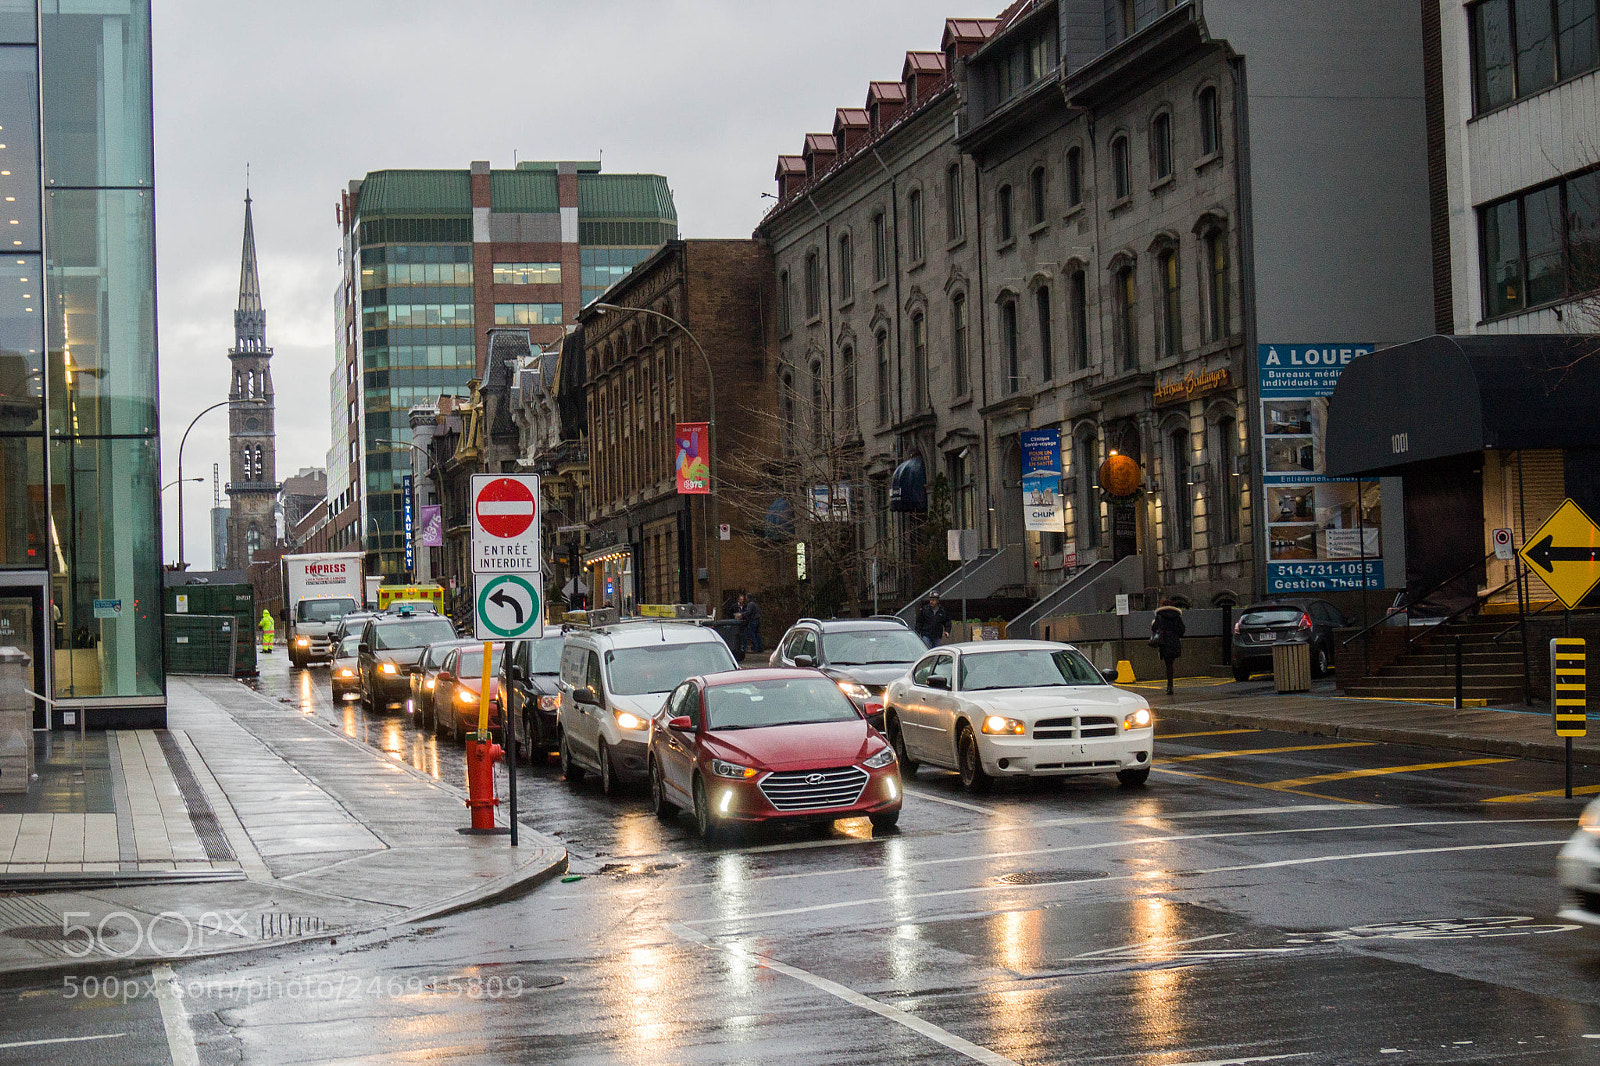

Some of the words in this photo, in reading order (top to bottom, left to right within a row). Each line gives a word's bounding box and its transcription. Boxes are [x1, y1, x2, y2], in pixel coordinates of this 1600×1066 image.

[1266, 346, 1281, 365] À
[1391, 432, 1409, 454] 1001
[1031, 510, 1056, 518] CHUM
[404, 479, 413, 567] RESTAURANT
[484, 543, 528, 556] ENTRÉE
[305, 563, 346, 574] EMPRESS
[480, 558, 532, 568] INTERDITE
[1278, 564, 1373, 575] 514-731-1095
[1274, 579, 1326, 589] Gestion
